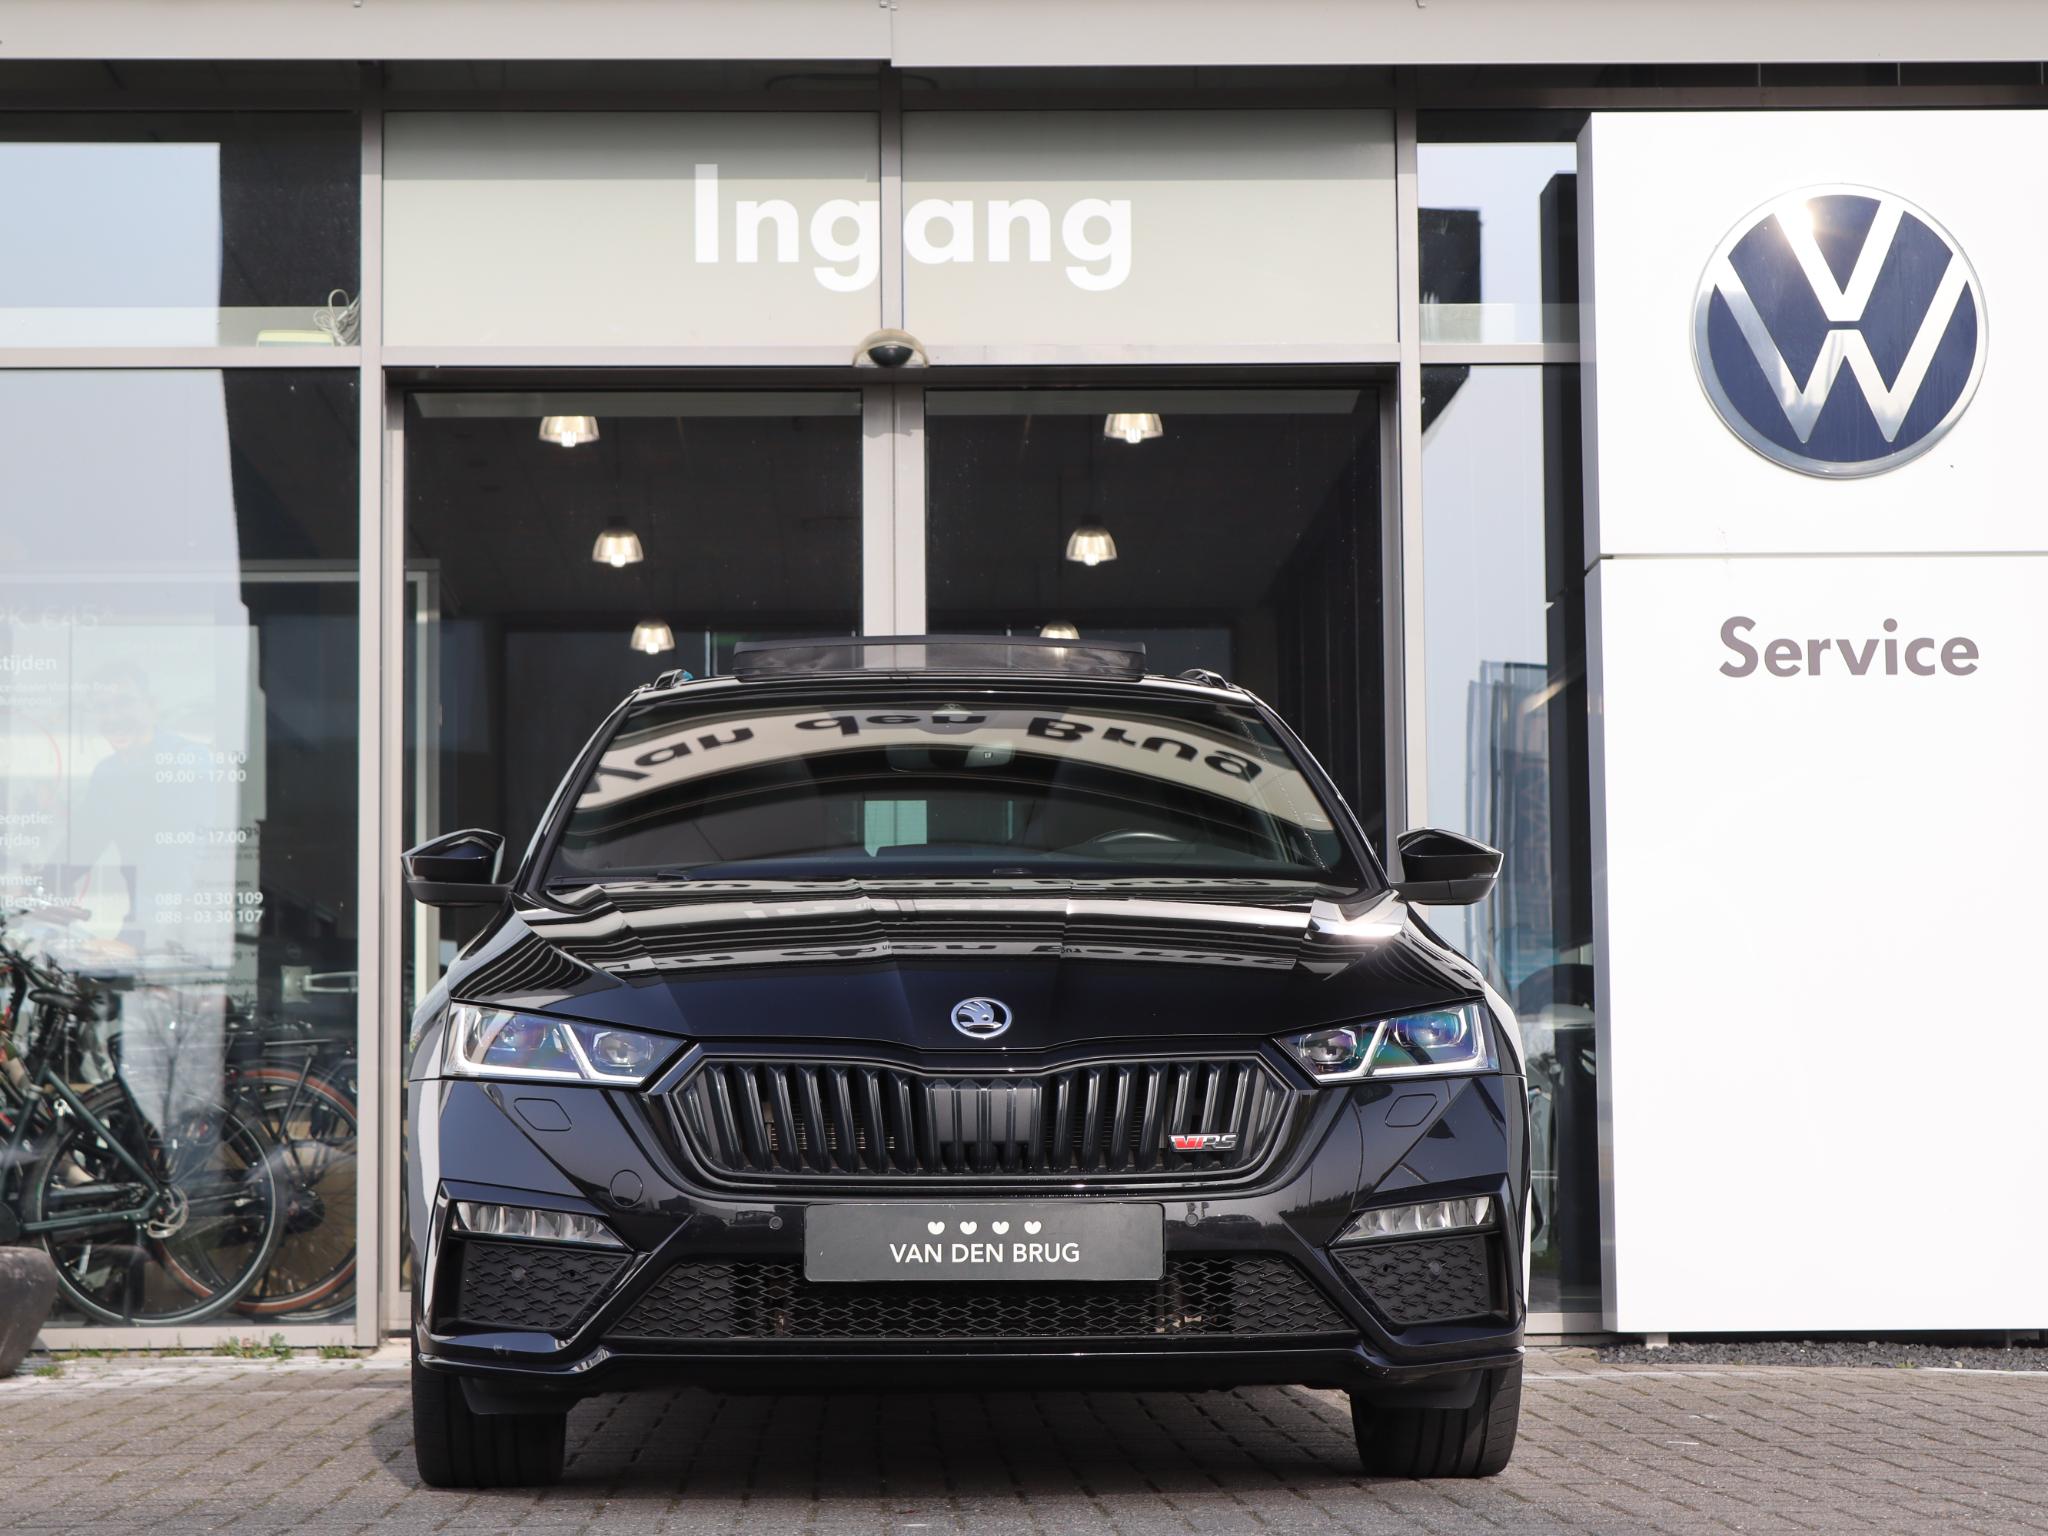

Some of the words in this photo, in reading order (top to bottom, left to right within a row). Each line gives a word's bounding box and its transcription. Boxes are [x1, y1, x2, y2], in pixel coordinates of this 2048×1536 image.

[694, 163, 1133, 292] Ingang
[1718, 615, 1980, 678] Service
[237, 892, 263, 905] 109
[237, 910, 263, 923] 107
[889, 1243, 943, 1264] VAN
[951, 1243, 1004, 1263] DEN
[1012, 1242, 1081, 1263] BRUG
